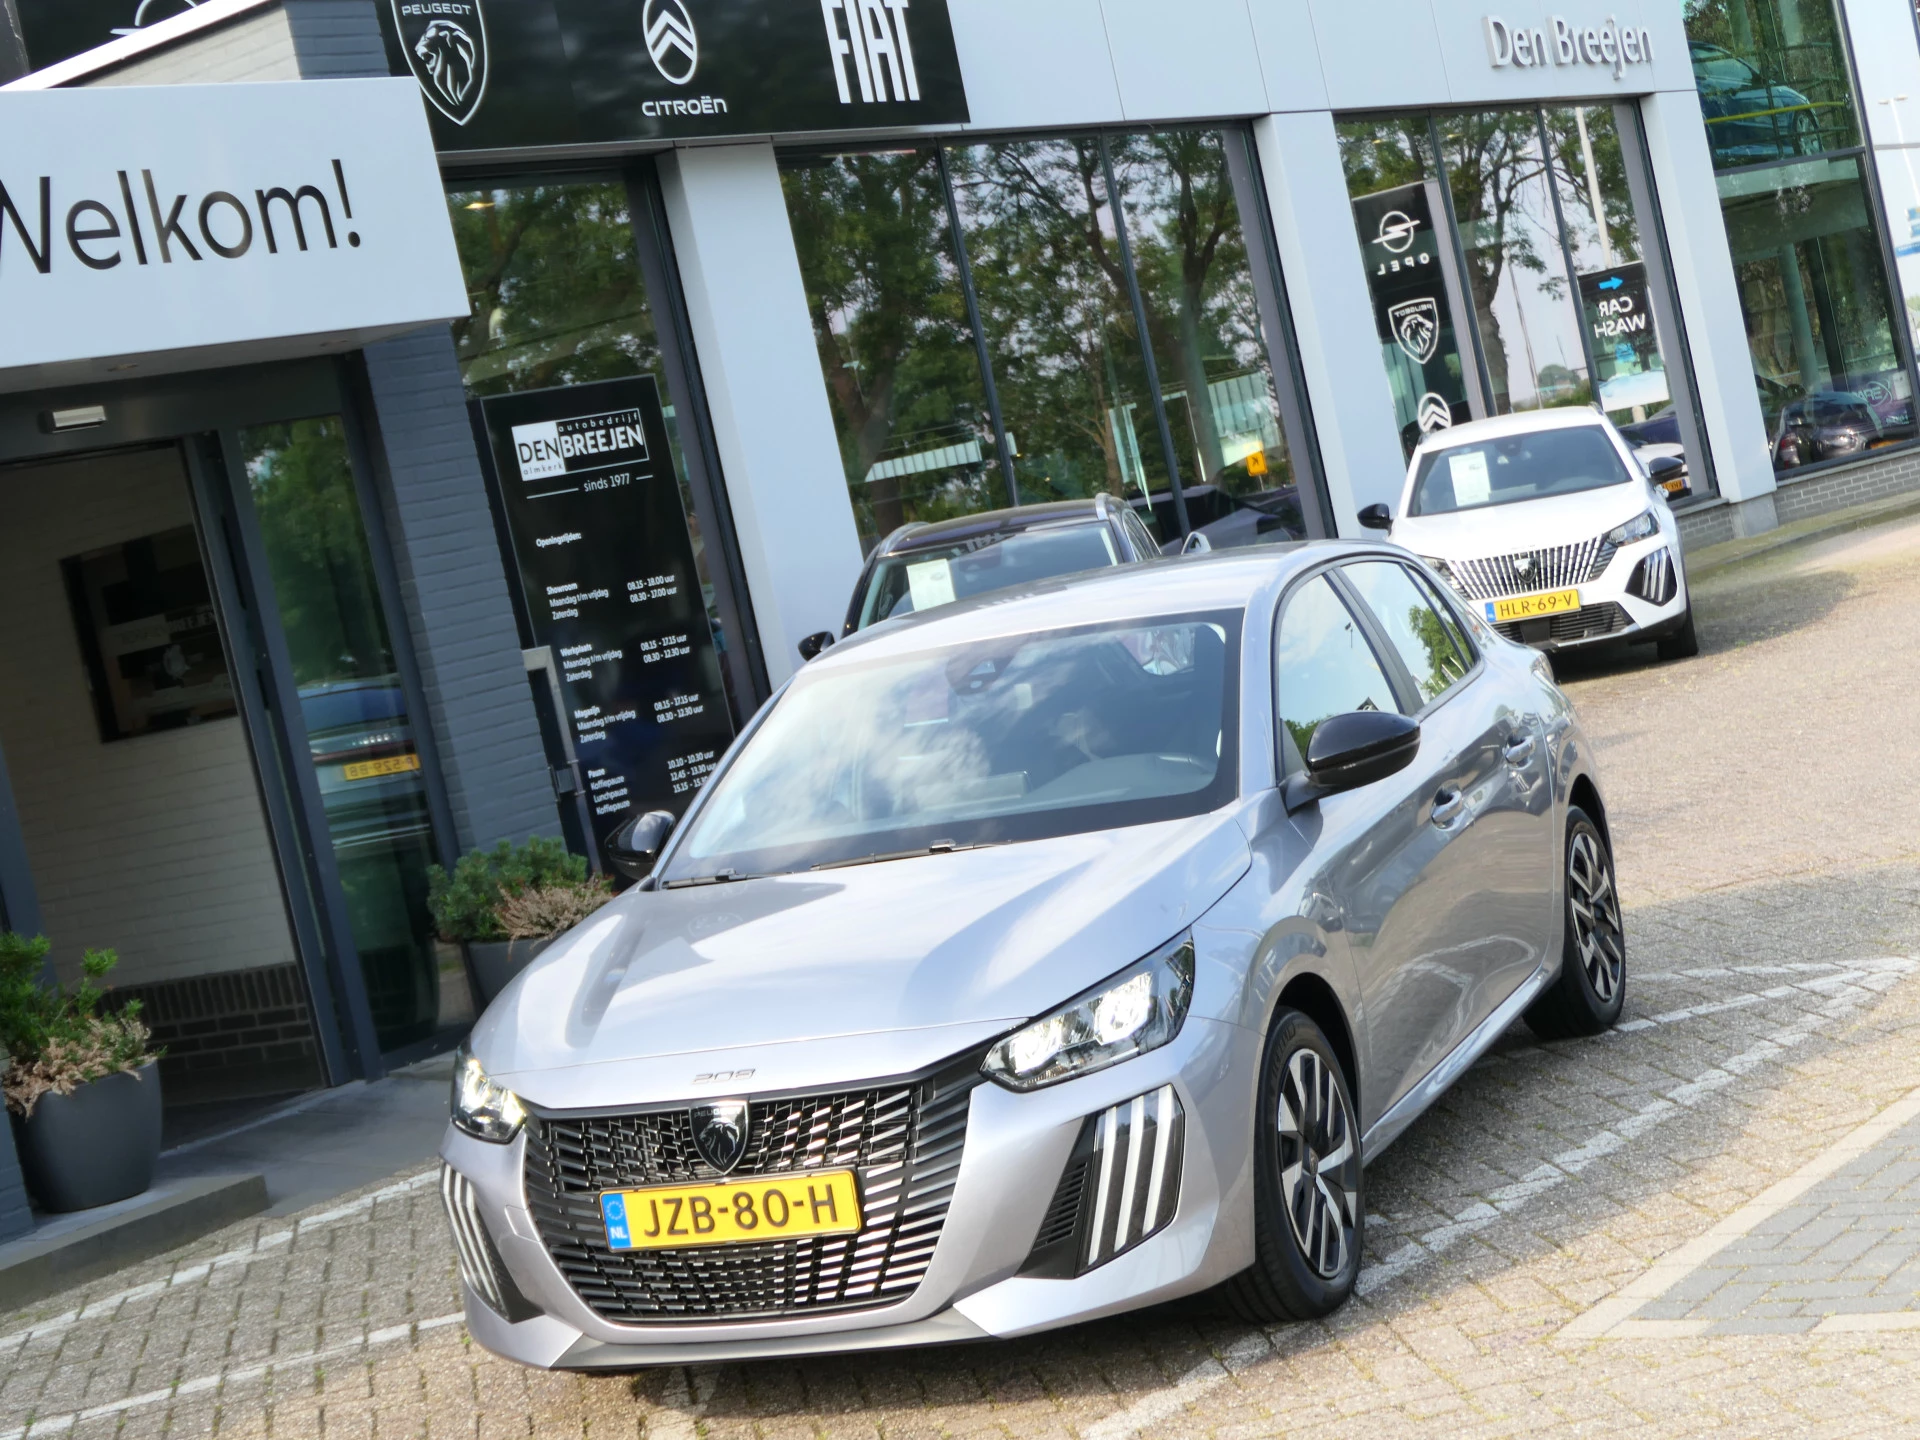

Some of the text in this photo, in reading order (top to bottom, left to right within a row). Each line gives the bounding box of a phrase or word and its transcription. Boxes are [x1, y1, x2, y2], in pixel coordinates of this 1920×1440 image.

[402, 2, 472, 16] PEUGEOT
[820, 0, 920, 104] FIAT
[1482, 13, 1655, 80] Den Breejen
[558, 412, 638, 433] autobedrijf
[517, 424, 643, 464] DEN BREEJEN
[523, 463, 564, 477] almkerk
[584, 472, 631, 493] sinds 1977
[664, 574, 675, 583] uur
[546, 582, 578, 595] Showroom
[666, 586, 678, 596] uur
[549, 588, 609, 608] Maandag t/m vrijdag
[1500, 594, 1573, 617] HLR-69-V
[552, 607, 579, 620] Zaterdag
[676, 634, 687, 643] uur
[560, 643, 592, 657] Werkplaats
[680, 646, 691, 655] uur
[563, 649, 623, 669] Maandag t/m vrijdag
[566, 669, 592, 682] Zaterdag
[688, 693, 699, 703] uur
[574, 705, 601, 719] Magazijn
[692, 704, 703, 714] uur
[577, 709, 636, 731] Maandag t/m vrijdag
[580, 730, 606, 744] Zaterdag
[703, 750, 714, 760] uur
[590, 775, 625, 791] Koffiepauze
[593, 787, 628, 803] Lunchpauze
[596, 799, 630, 816] Koffiepauze
[691, 1068, 756, 1085] 208
[644, 1183, 838, 1238] JZB-80-H
[610, 1225, 628, 1240] NL
